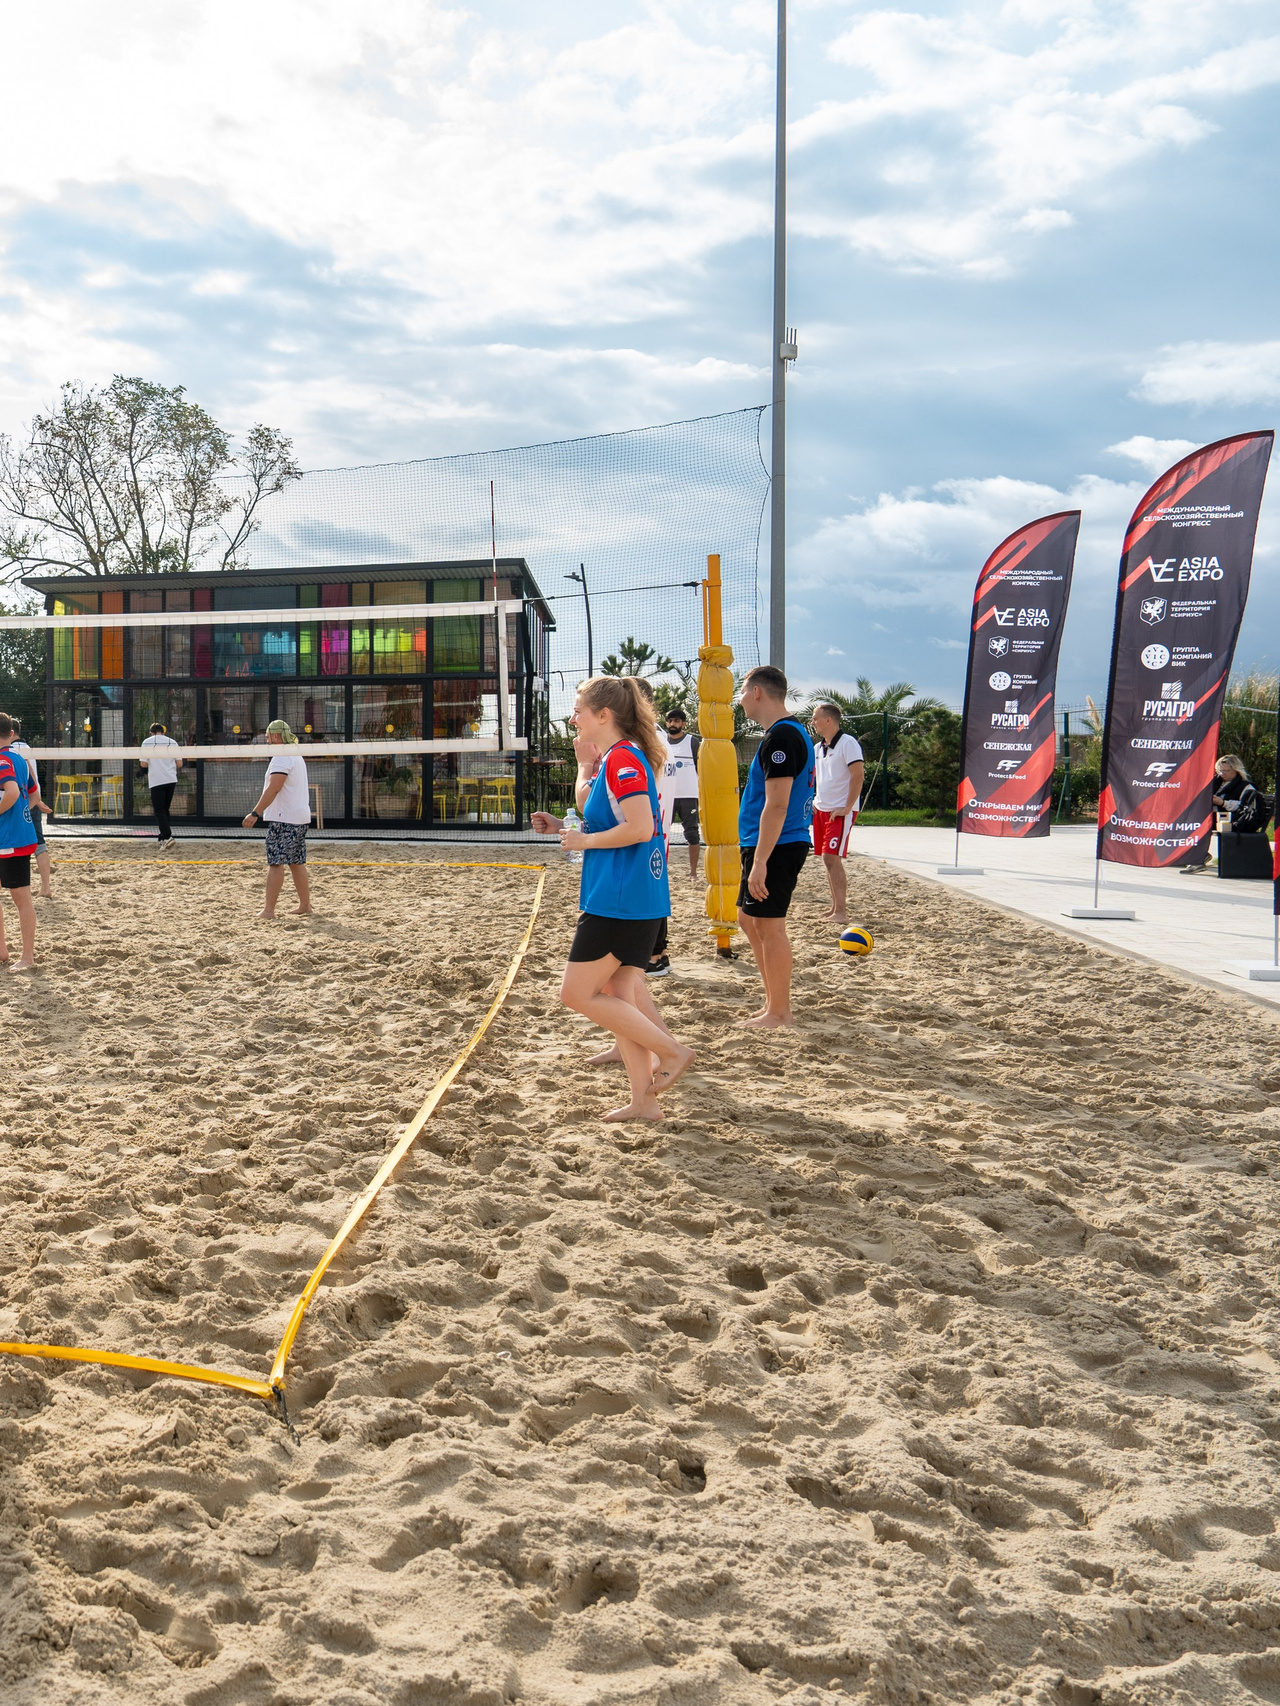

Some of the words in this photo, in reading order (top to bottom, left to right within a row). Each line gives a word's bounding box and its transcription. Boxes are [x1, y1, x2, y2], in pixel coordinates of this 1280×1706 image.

[1156, 504, 1231, 514] МЕЖДУНАРОДНЫЙ
[1143, 511, 1244, 522] СЕЛЬСКОХОЗЯЙСТВЕННЫЙ
[1172, 520, 1211, 528] КОНГРЕСС
[1179, 556, 1220, 570] ASIA
[1178, 568, 1224, 582] EXPO
[1018, 608, 1048, 618] ASIA
[1017, 617, 1050, 627] EXPO
[1142, 700, 1195, 717] РУСАГРО
[991, 713, 1030, 727] РУСАГРО
[983, 741, 1032, 752] СЕНЕЖСКАЯ
[1131, 738, 1193, 750] СЕНЕЖСКАЯ
[1132, 779, 1182, 788] Protect&Feed
[829, 836, 839, 849] 6
